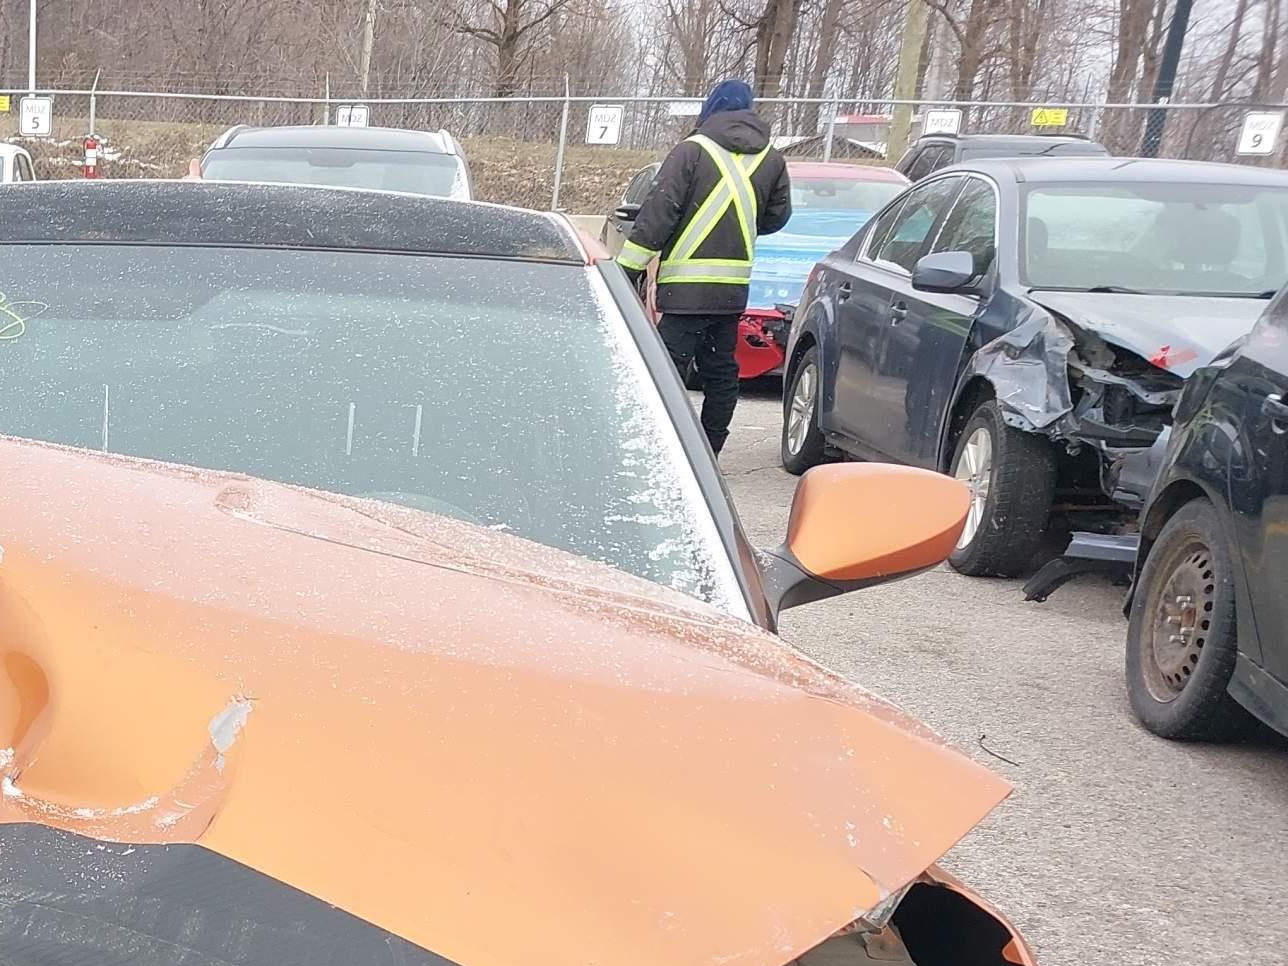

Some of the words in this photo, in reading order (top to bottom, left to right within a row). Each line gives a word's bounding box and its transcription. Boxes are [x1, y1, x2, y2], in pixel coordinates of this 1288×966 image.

[31, 116, 41, 130] 5
[594, 113, 617, 123] MDZ
[930, 116, 954, 127] MDZ
[598, 125, 609, 140] 7
[1250, 133, 1263, 149] 9
